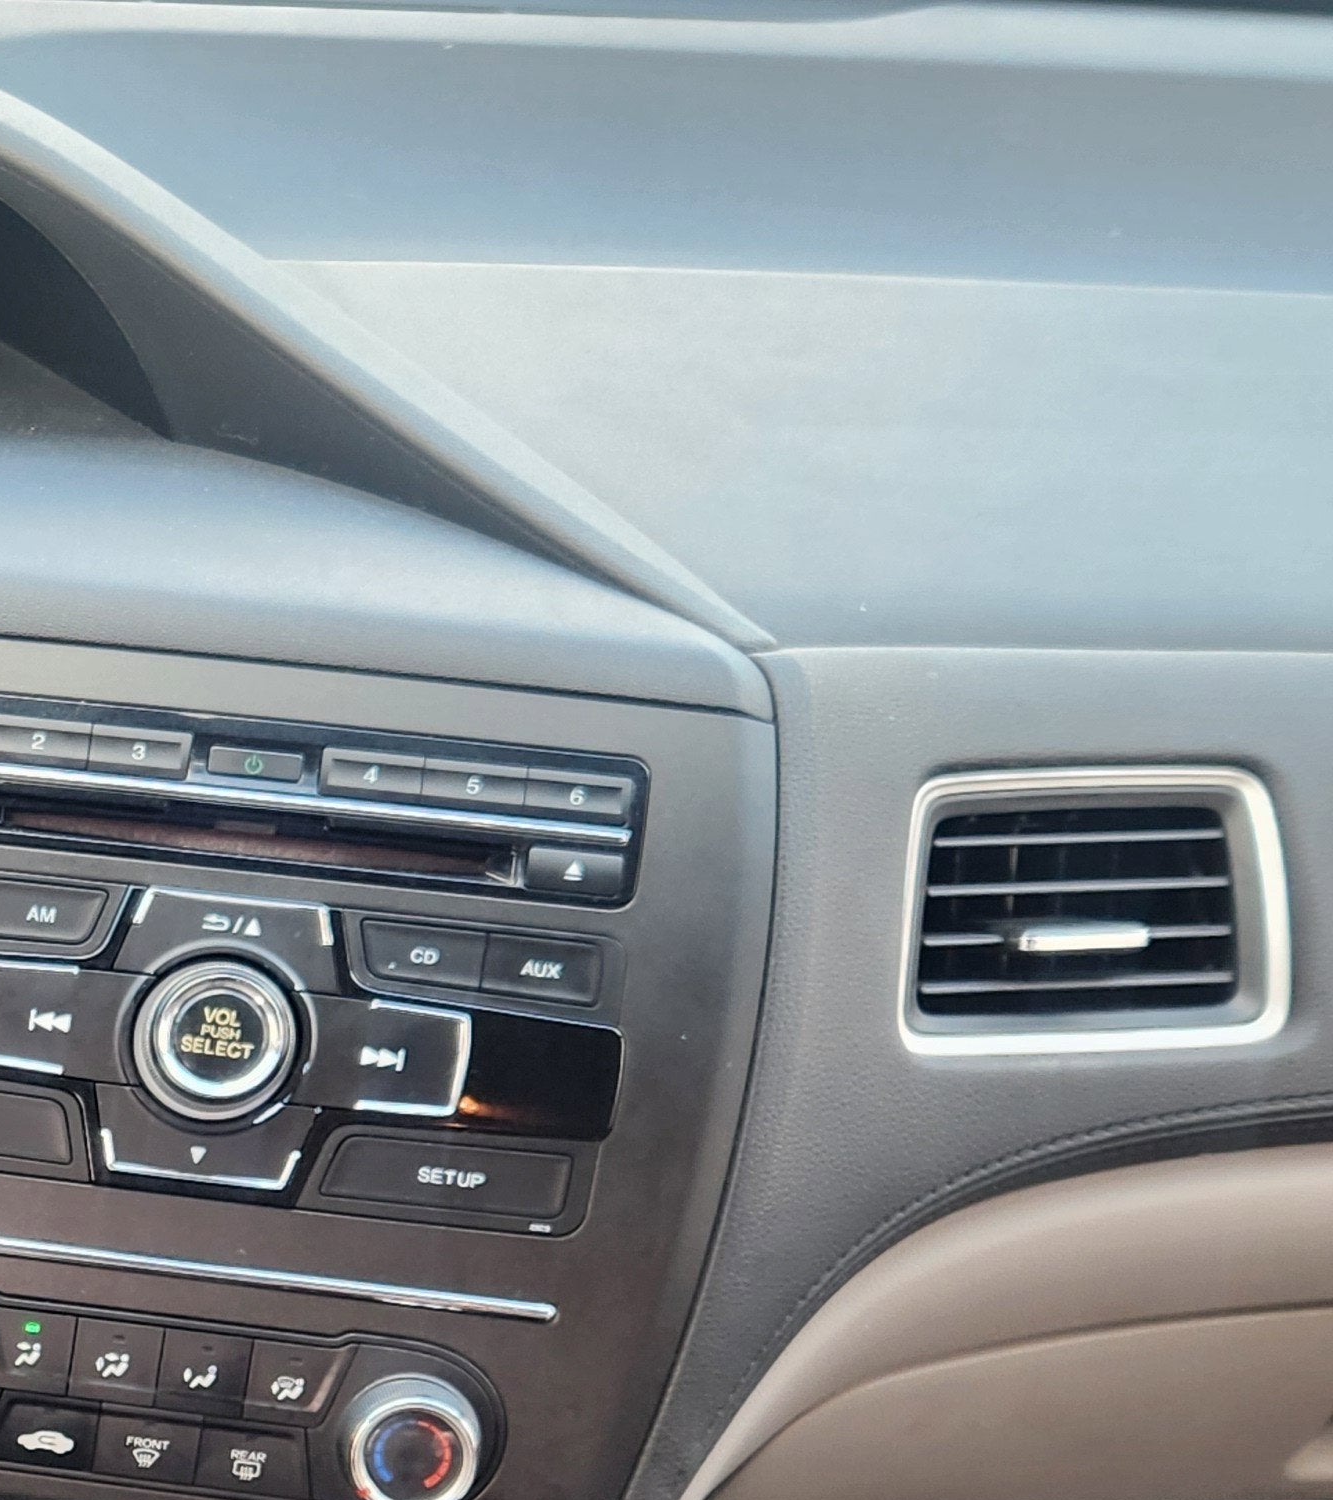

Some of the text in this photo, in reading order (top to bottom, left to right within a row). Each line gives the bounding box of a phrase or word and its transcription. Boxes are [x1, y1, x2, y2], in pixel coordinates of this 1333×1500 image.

[32, 732, 46, 750] 2
[132, 742, 146, 761] 3
[362, 765, 380, 784] 4
[465, 775, 484, 796] 5
[569, 786, 585, 806] 6
[25, 905, 58, 925] AM
[409, 946, 440, 965] CD
[520, 958, 565, 980] AUX
[202, 1006, 241, 1029] VOL
[200, 1025, 241, 1040] PUSH
[180, 1035, 255, 1061] SELECT
[417, 1165, 487, 1189] SETUP
[126, 1434, 171, 1451] FRONT
[230, 1448, 267, 1464] REAR
